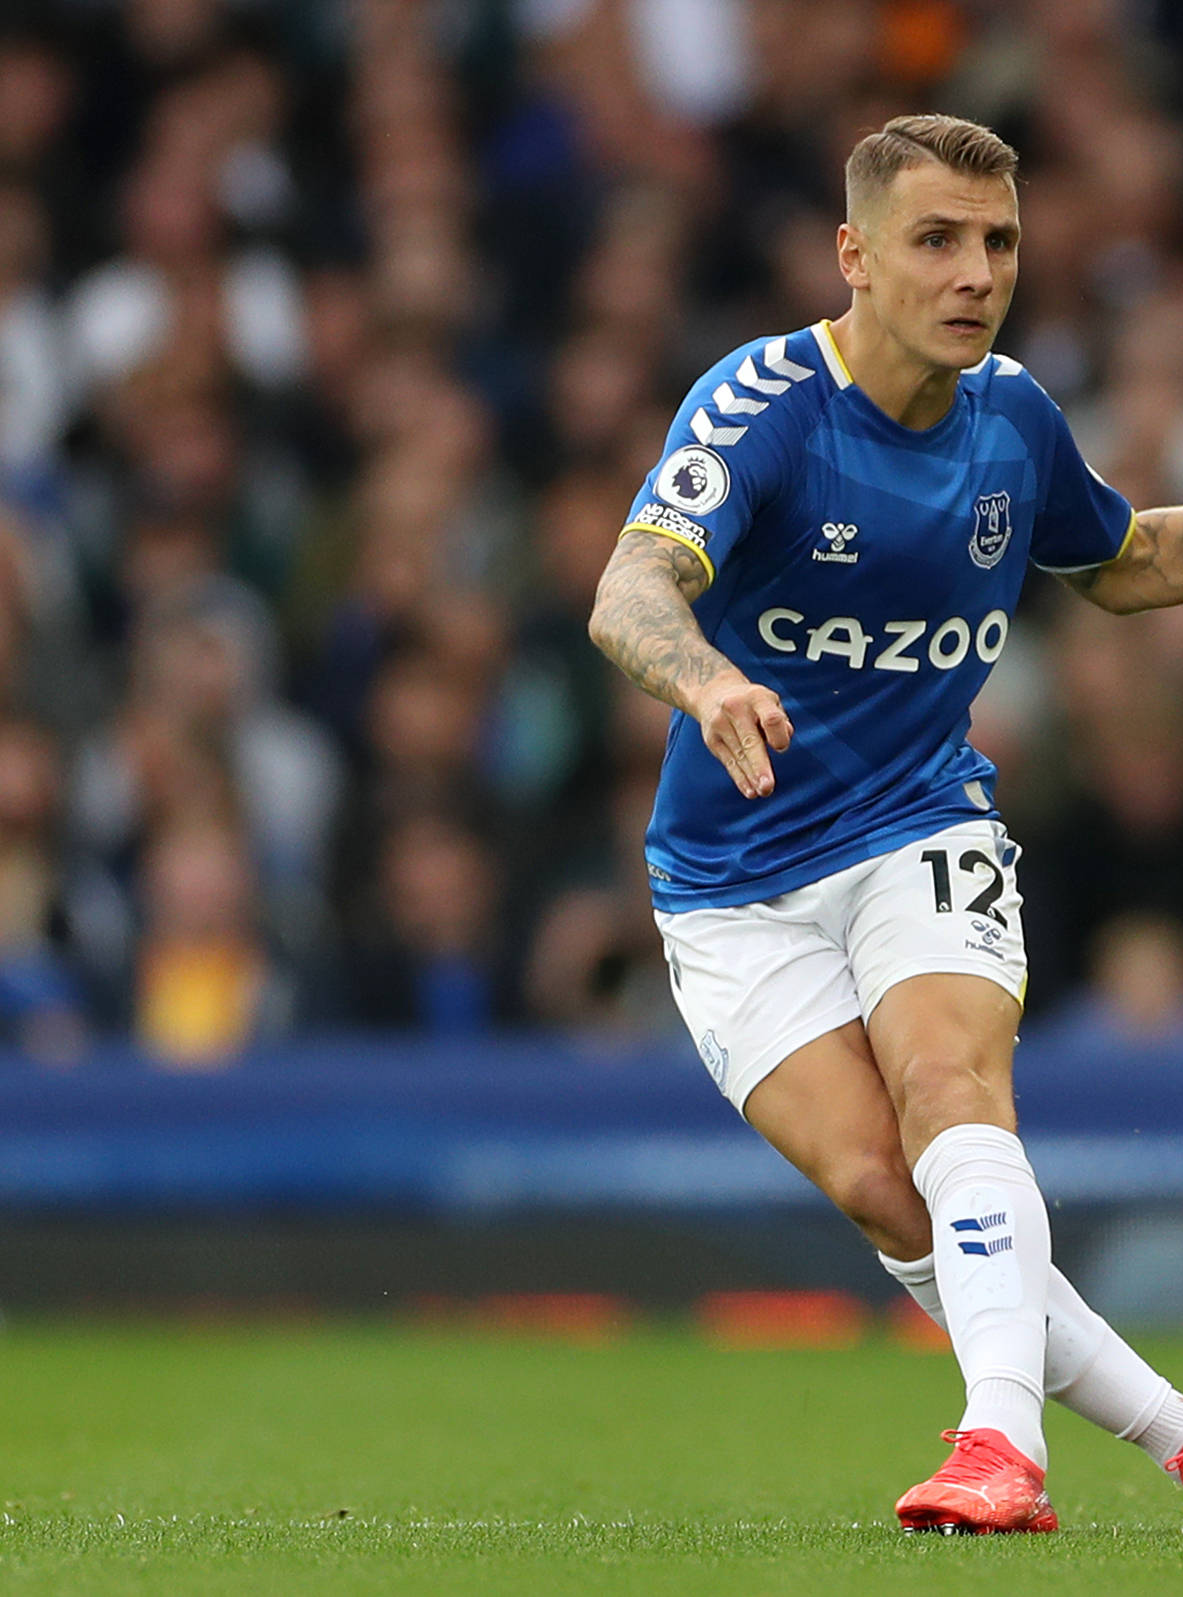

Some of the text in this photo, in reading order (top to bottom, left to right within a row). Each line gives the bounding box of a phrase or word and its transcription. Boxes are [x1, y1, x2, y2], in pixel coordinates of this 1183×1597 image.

[641, 503, 705, 537] No room
[812, 548, 858, 563] hummel
[758, 607, 1009, 672] CAZOO
[920, 849, 1008, 931] 12
